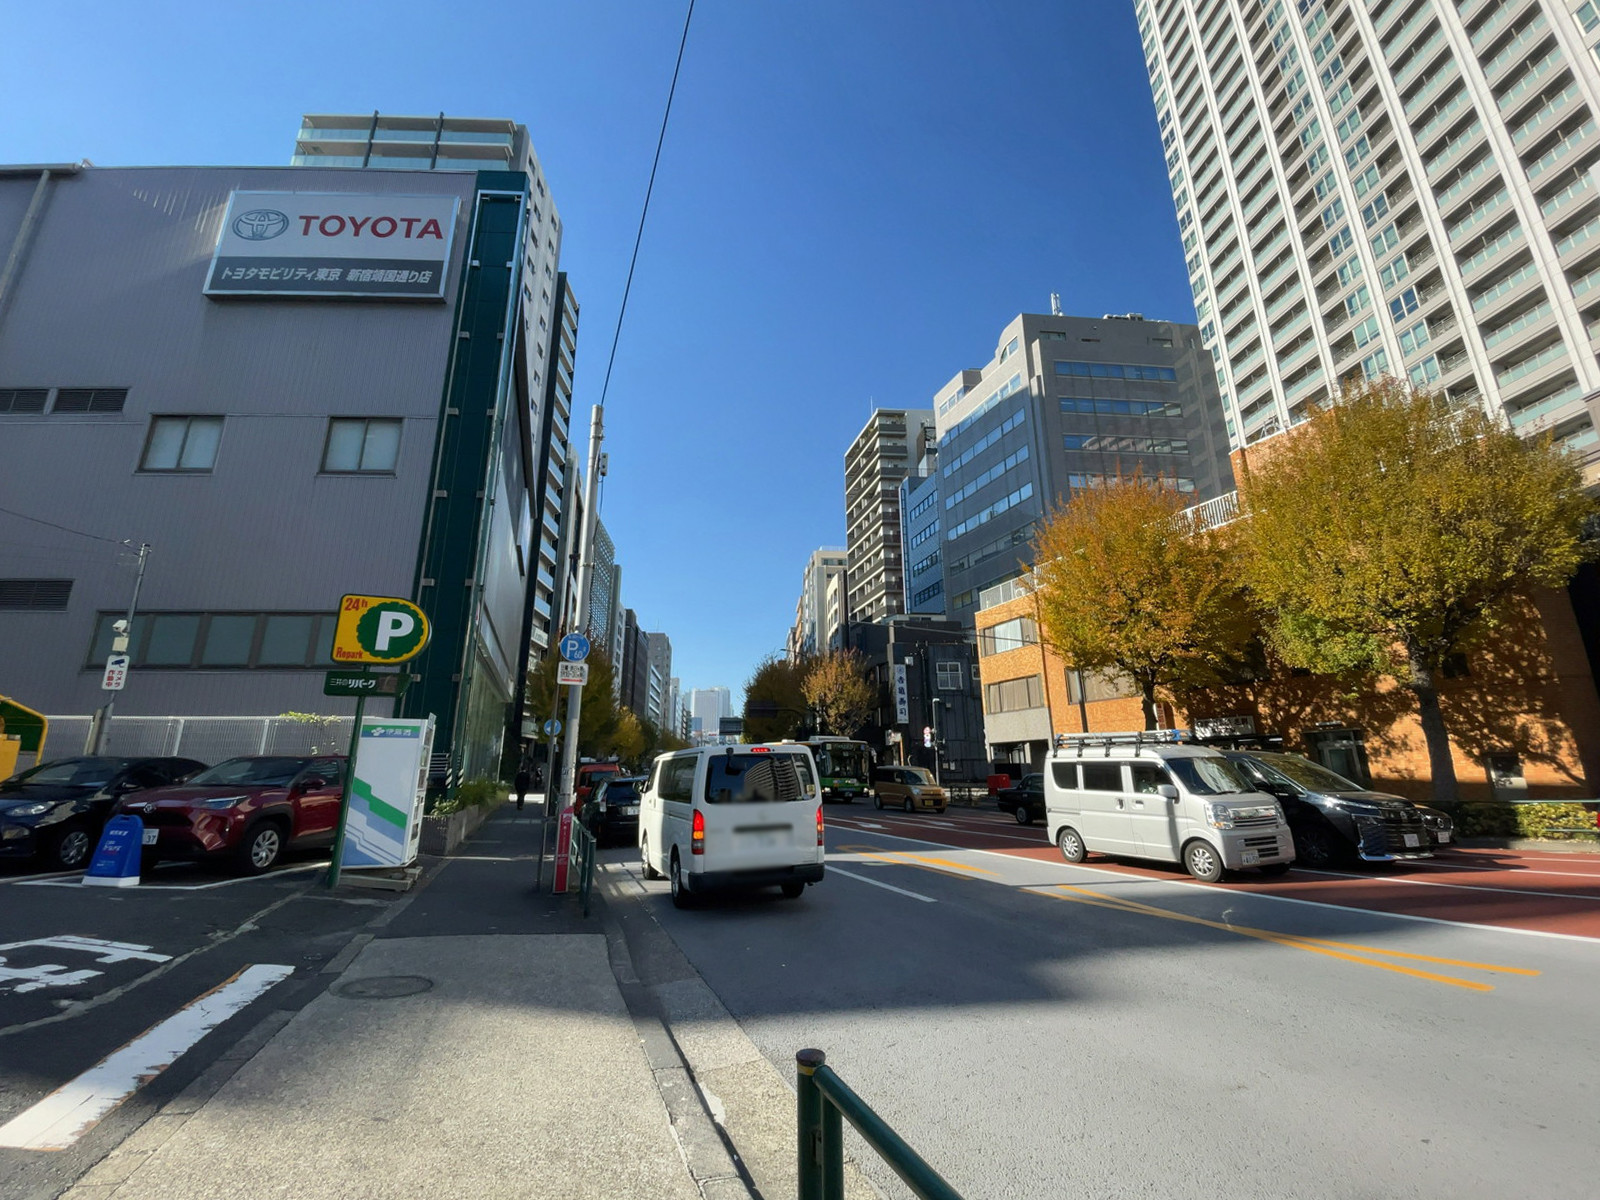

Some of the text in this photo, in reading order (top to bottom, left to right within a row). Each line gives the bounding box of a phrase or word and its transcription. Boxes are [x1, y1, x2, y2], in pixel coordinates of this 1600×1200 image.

[299, 215, 443, 239] TOYOTA
[221, 266, 432, 284] トヨタモビリティ東京 新宿靖国通り店
[374, 611, 414, 651] P
[335, 647, 363, 659] Repark
[567, 640, 579, 658] P
[114, 670, 124, 687] カメラ
[329, 678, 376, 689] 三井のリパーク
